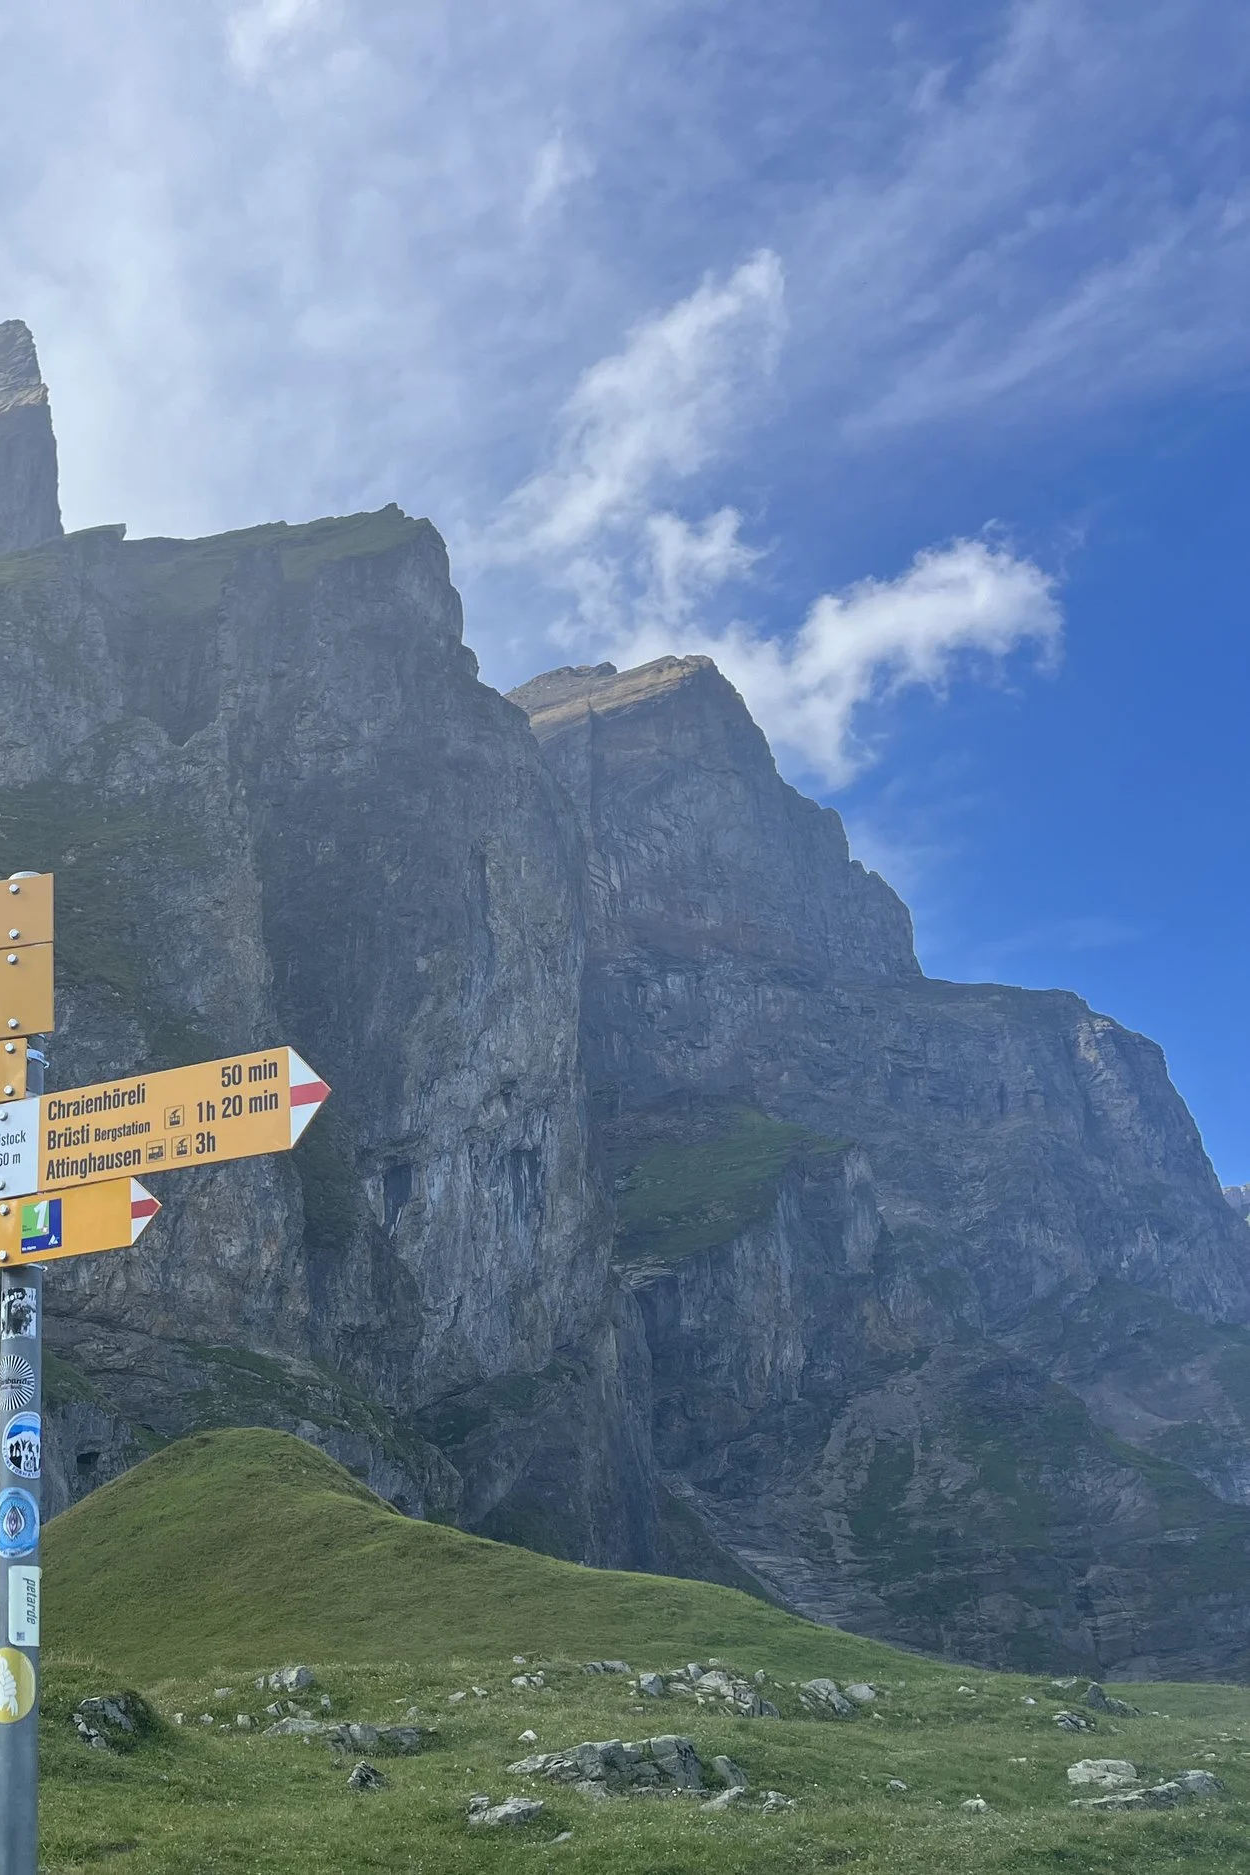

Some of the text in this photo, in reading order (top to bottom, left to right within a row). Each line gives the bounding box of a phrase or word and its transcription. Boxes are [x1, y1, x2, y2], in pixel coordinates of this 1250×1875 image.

[47, 1059, 278, 1121] Chraienhöreli 50 min
[47, 1123, 90, 1151] Brüsti
[94, 1121, 151, 1142] Bergstation
[221, 1094, 243, 1119] 20
[249, 1089, 279, 1114] min
[12, 1153, 21, 1165] m
[46, 1148, 142, 1181] Attinghausen
[33, 1200, 48, 1230] 1
[22, 1577, 38, 1625] petarde
